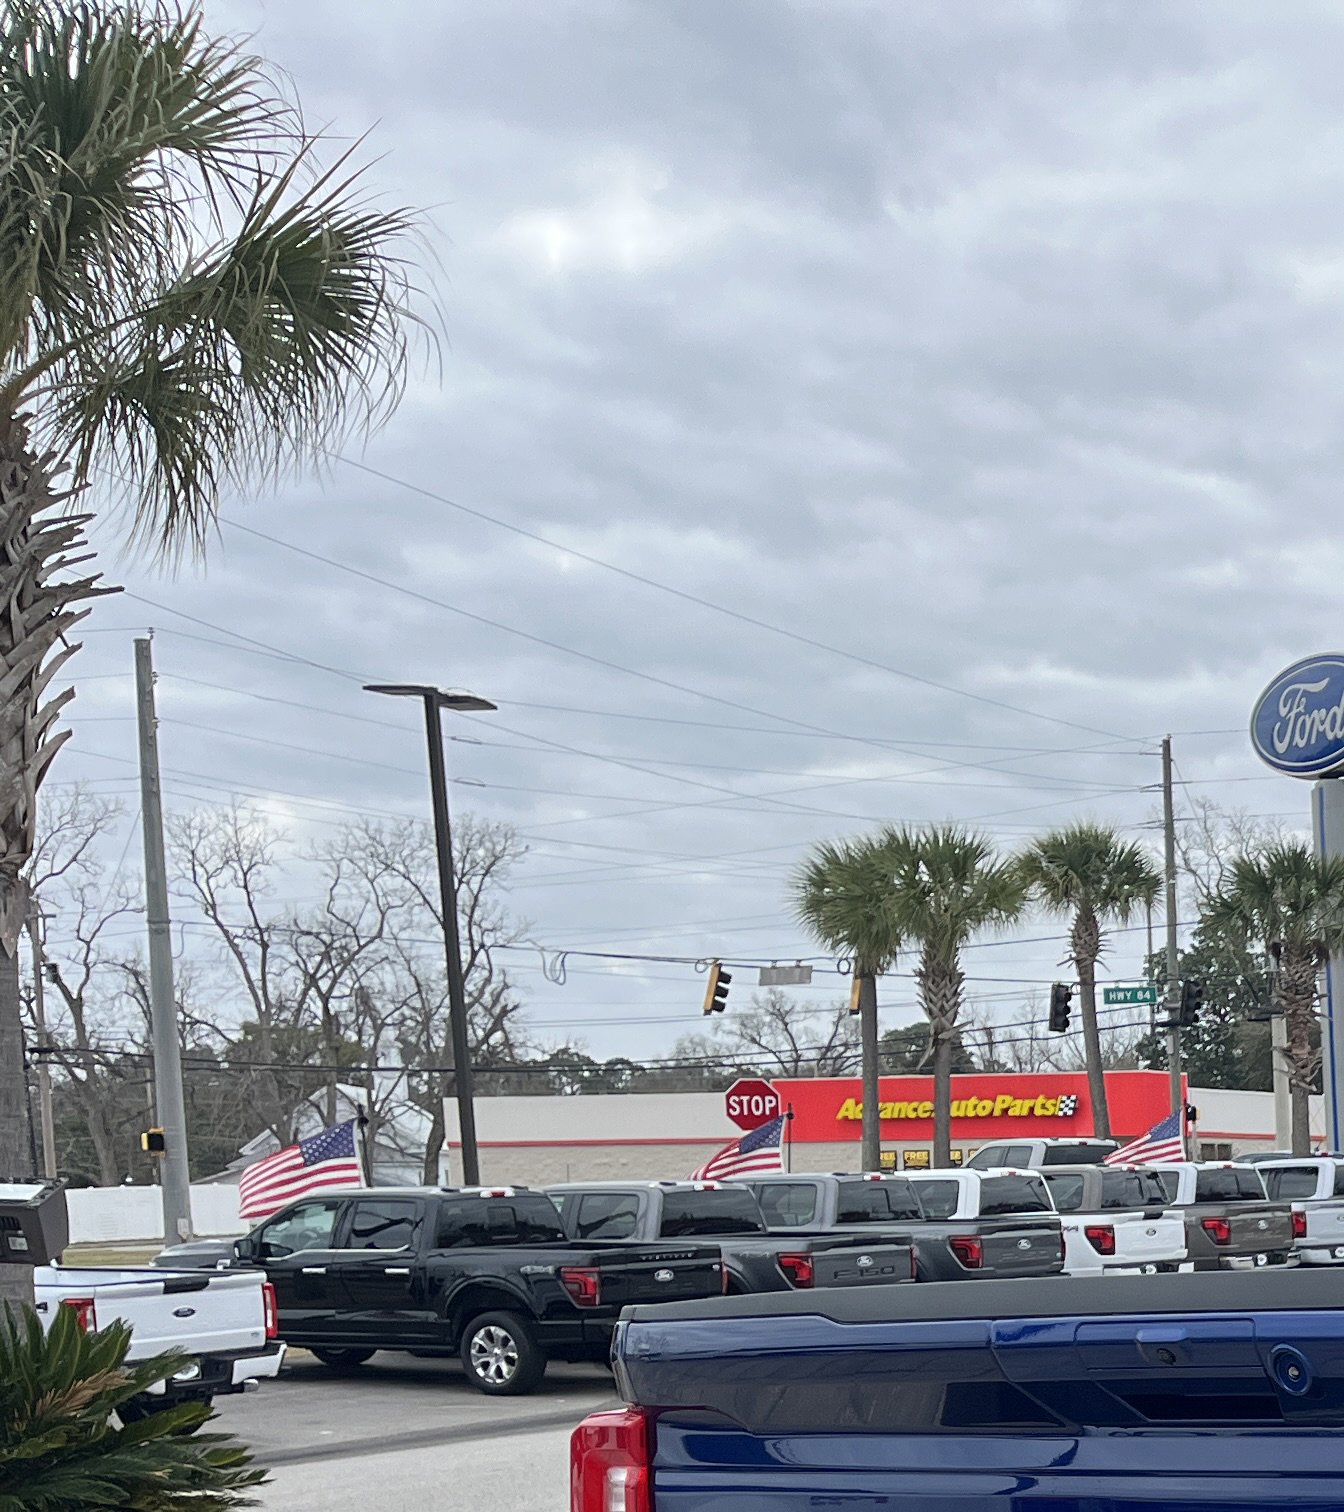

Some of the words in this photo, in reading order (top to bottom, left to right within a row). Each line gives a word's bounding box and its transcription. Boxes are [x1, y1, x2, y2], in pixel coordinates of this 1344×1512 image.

[1108, 990, 1132, 1001] HWY
[729, 1095, 777, 1116] STOP
[836, 1098, 934, 1120] Aance
[993, 1094, 1057, 1117] Parts
[904, 1150, 929, 1160] FREE
